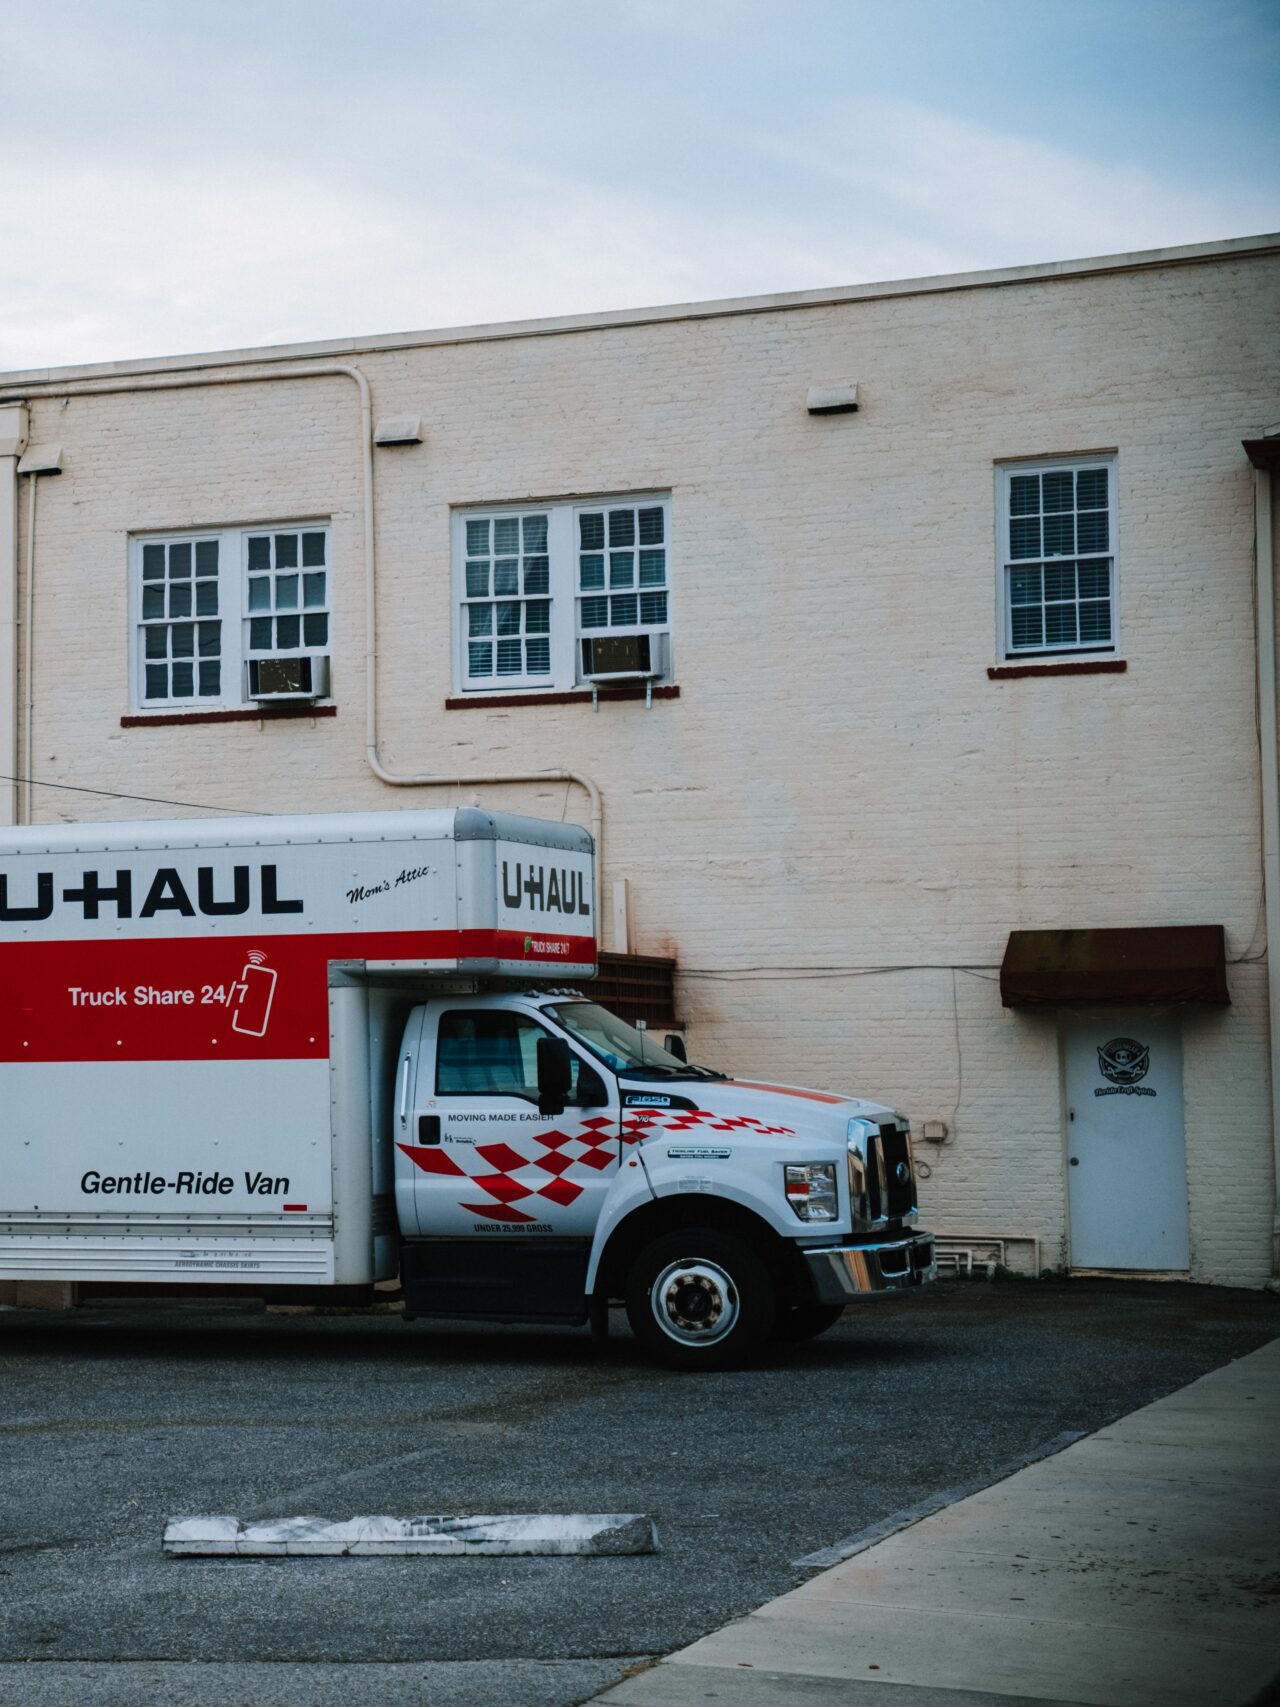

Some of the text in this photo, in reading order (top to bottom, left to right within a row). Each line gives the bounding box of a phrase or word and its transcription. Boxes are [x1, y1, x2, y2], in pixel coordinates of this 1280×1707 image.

[346, 866, 430, 904] Mom's Attic
[502, 860, 590, 916] U-HAUL
[68, 981, 249, 1008] Truck Share 24/7
[448, 1112, 554, 1122] MOVING MADE EASIER
[80, 1170, 290, 1195] Gentle-Ride Van
[474, 1223, 501, 1232] UNDER
[527, 1224, 553, 1232] GROSS
